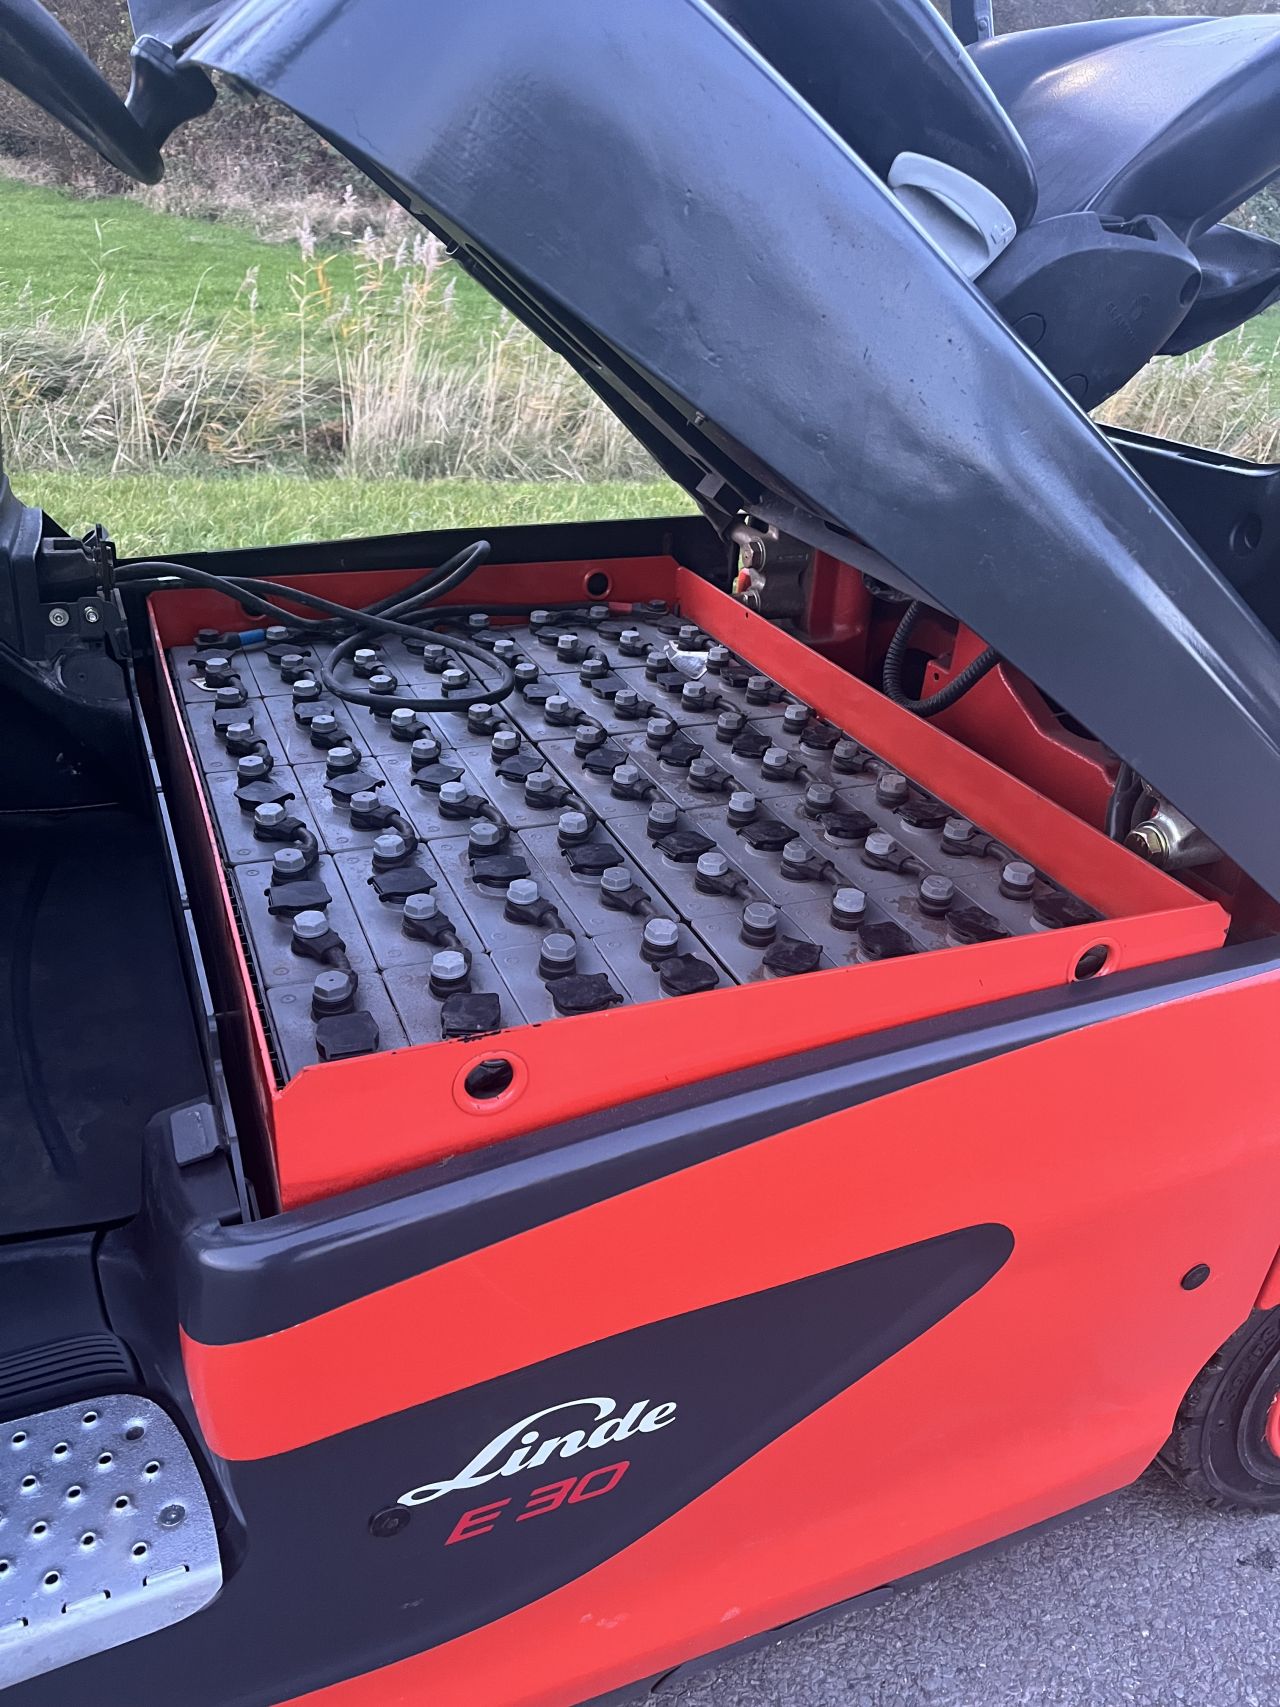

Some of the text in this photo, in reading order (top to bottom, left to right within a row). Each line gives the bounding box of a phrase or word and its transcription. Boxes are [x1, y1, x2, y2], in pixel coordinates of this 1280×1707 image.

[397, 1397, 677, 1506] Linde
[444, 1460, 630, 1546] E 30
